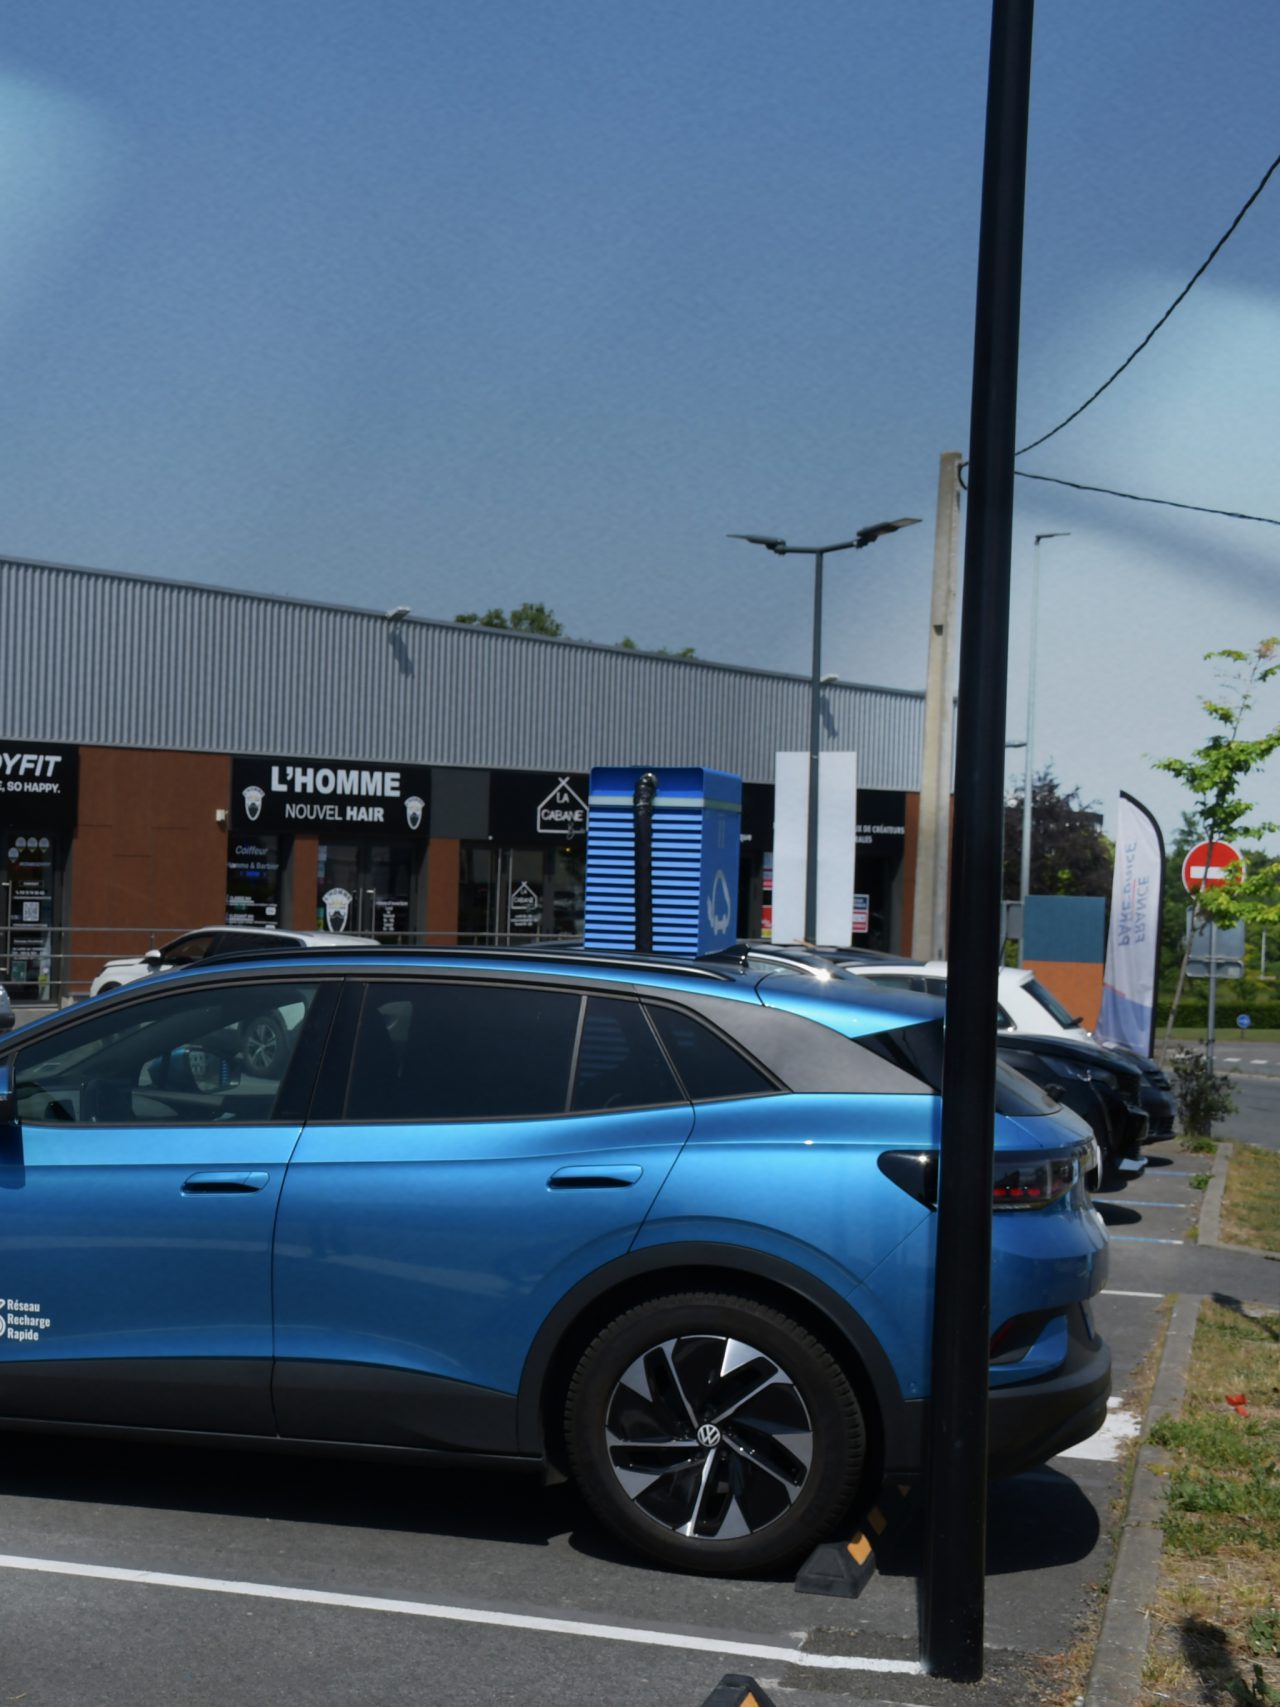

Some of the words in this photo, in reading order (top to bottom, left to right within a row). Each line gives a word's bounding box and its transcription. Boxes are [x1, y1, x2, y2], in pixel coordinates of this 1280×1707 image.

[7, 781, 23, 792] SO
[24, 782, 61, 794] HAPPY.
[271, 765, 401, 798] L'HOMME
[556, 791, 567, 803] LA
[285, 803, 343, 820] NOUVEL
[346, 805, 385, 822] HAIR
[541, 808, 585, 822] CABANE
[7, 1299, 41, 1313] Réseau
[7, 1313, 51, 1329] Recharge
[7, 1327, 40, 1342] Rapide
